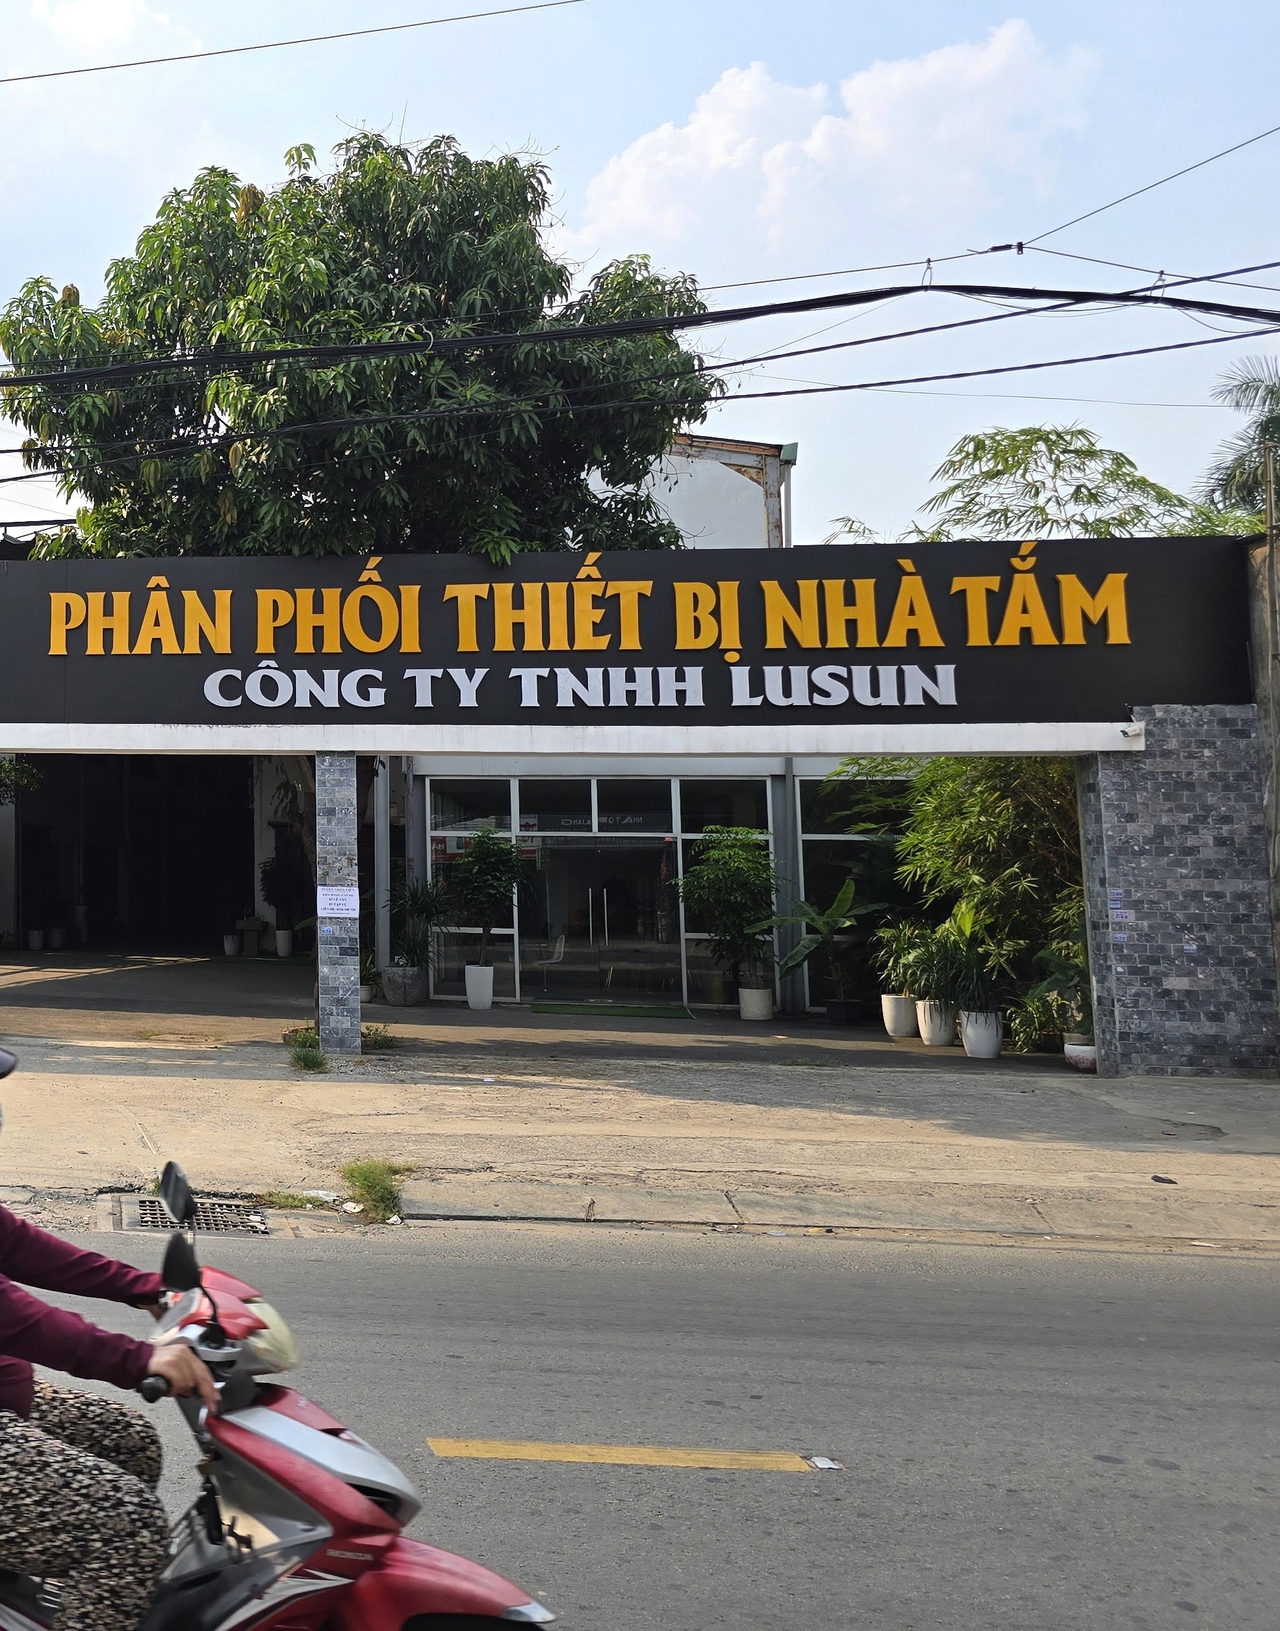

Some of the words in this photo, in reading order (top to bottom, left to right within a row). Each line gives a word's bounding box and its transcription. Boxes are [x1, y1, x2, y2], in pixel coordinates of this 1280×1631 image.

[48, 576, 233, 655] PHÂN
[255, 556, 422, 654] PHỐI
[443, 551, 654, 652] THIẾT
[673, 581, 742, 663] BỊ
[760, 558, 946, 649] NHÀ
[949, 541, 1133, 646] TẮM
[203, 659, 387, 708] CÔNG
[402, 667, 490, 708] TY
[508, 666, 706, 708] TNHH
[729, 664, 959, 707] LUSUN
